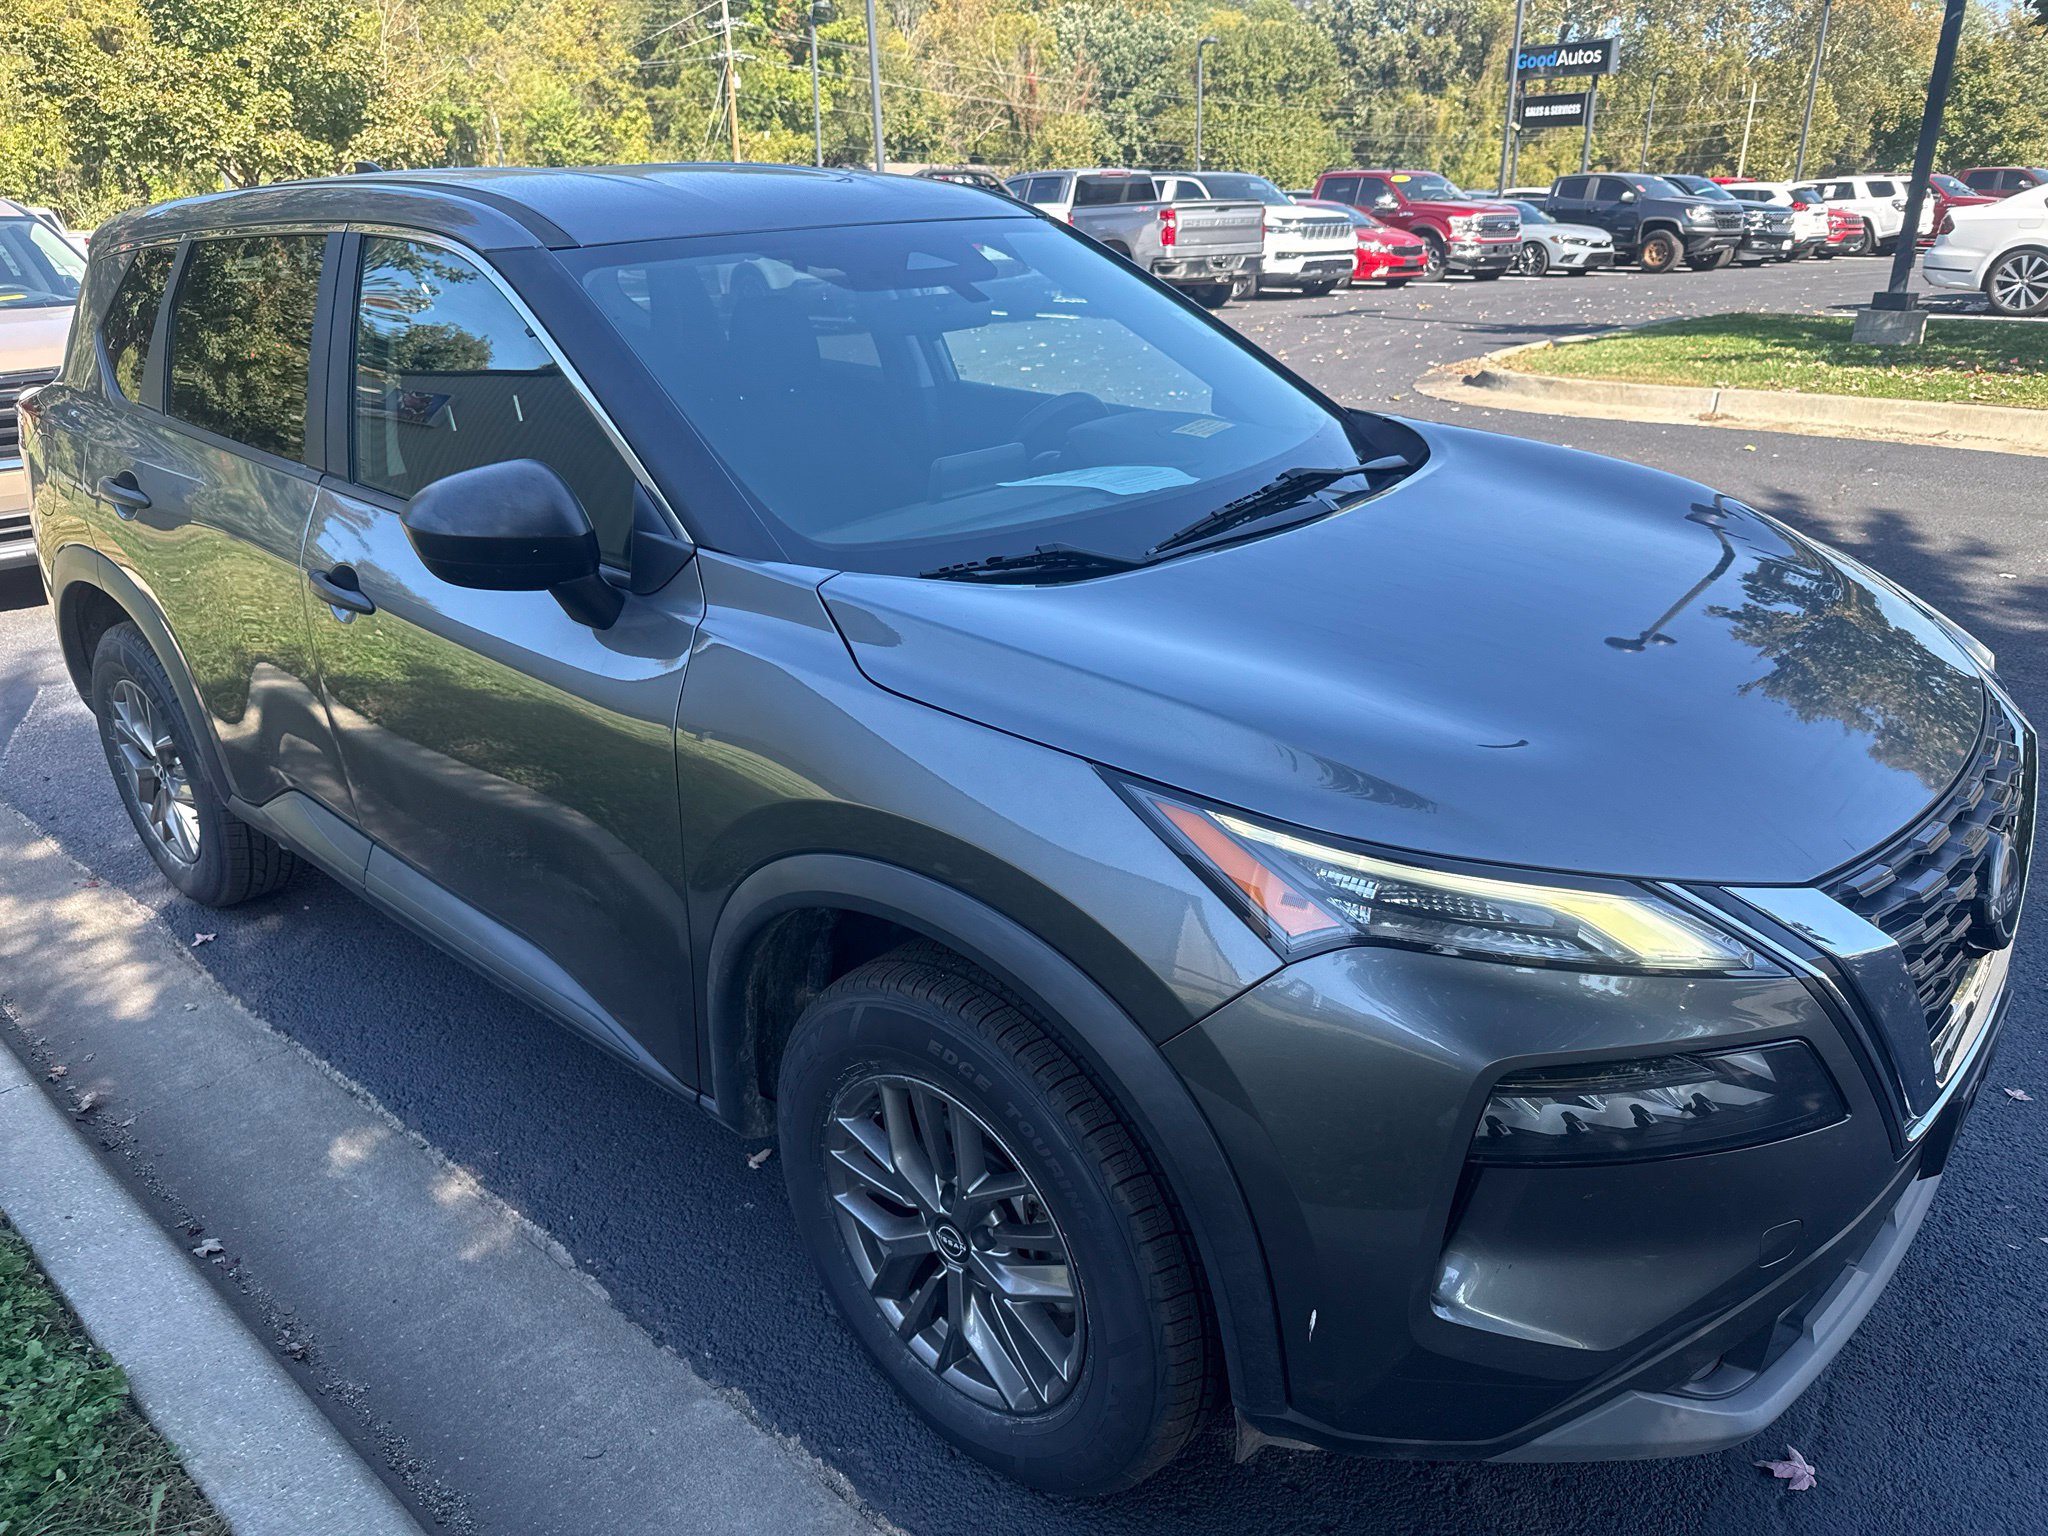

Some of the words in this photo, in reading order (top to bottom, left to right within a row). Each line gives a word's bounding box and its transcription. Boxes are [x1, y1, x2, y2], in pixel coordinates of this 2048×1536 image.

[1525, 105, 1544, 117] SALES
[1991, 881, 2018, 920] NISS
[927, 1039, 992, 1092] EDGE
[1004, 1101, 1093, 1229] TOURING
[936, 1229, 967, 1252] NISSAN
